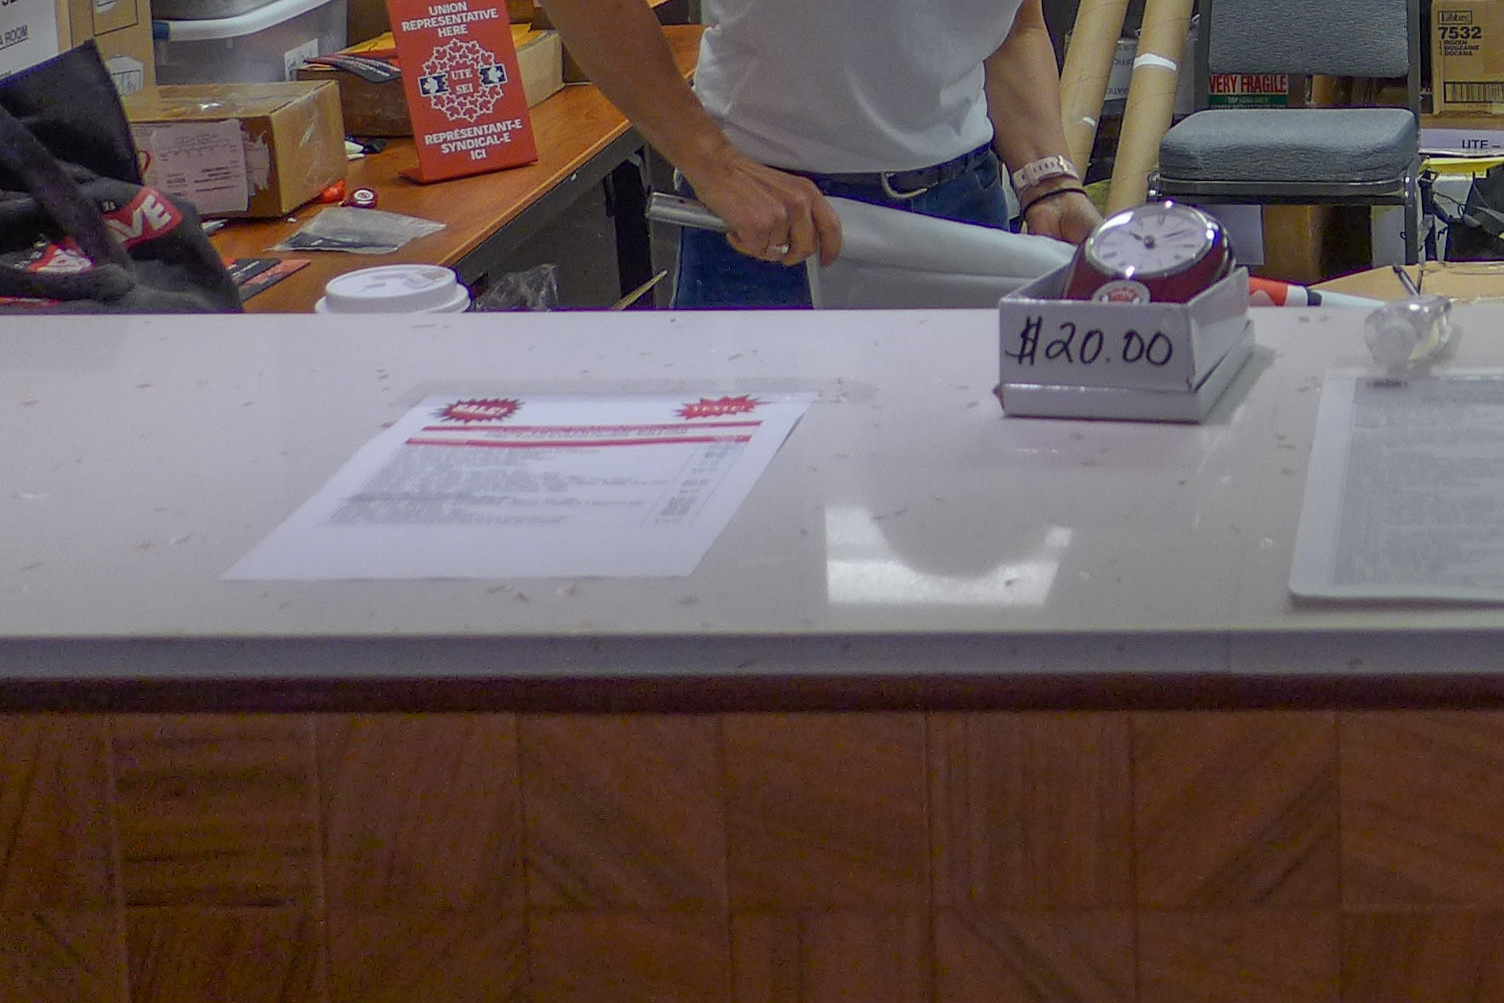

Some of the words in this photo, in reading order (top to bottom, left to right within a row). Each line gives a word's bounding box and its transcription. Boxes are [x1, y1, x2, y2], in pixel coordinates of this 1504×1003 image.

[428, 1, 468, 16] UNION
[401, 8, 499, 32] REPRESENTATIVE
[438, 24, 469, 38] HERE
[1438, 26, 1483, 40] 7532
[451, 69, 474, 80] UTE
[455, 82, 474, 94] SEI
[1209, 75, 1237, 93] VERY
[1240, 74, 1287, 94] FRAGILE
[440, 133, 511, 154] SYNDICAL-E
[1462, 139, 1489, 149] UTE
[470, 148, 486, 160] ICI
[1004, 314, 1174, 366] $20.00
